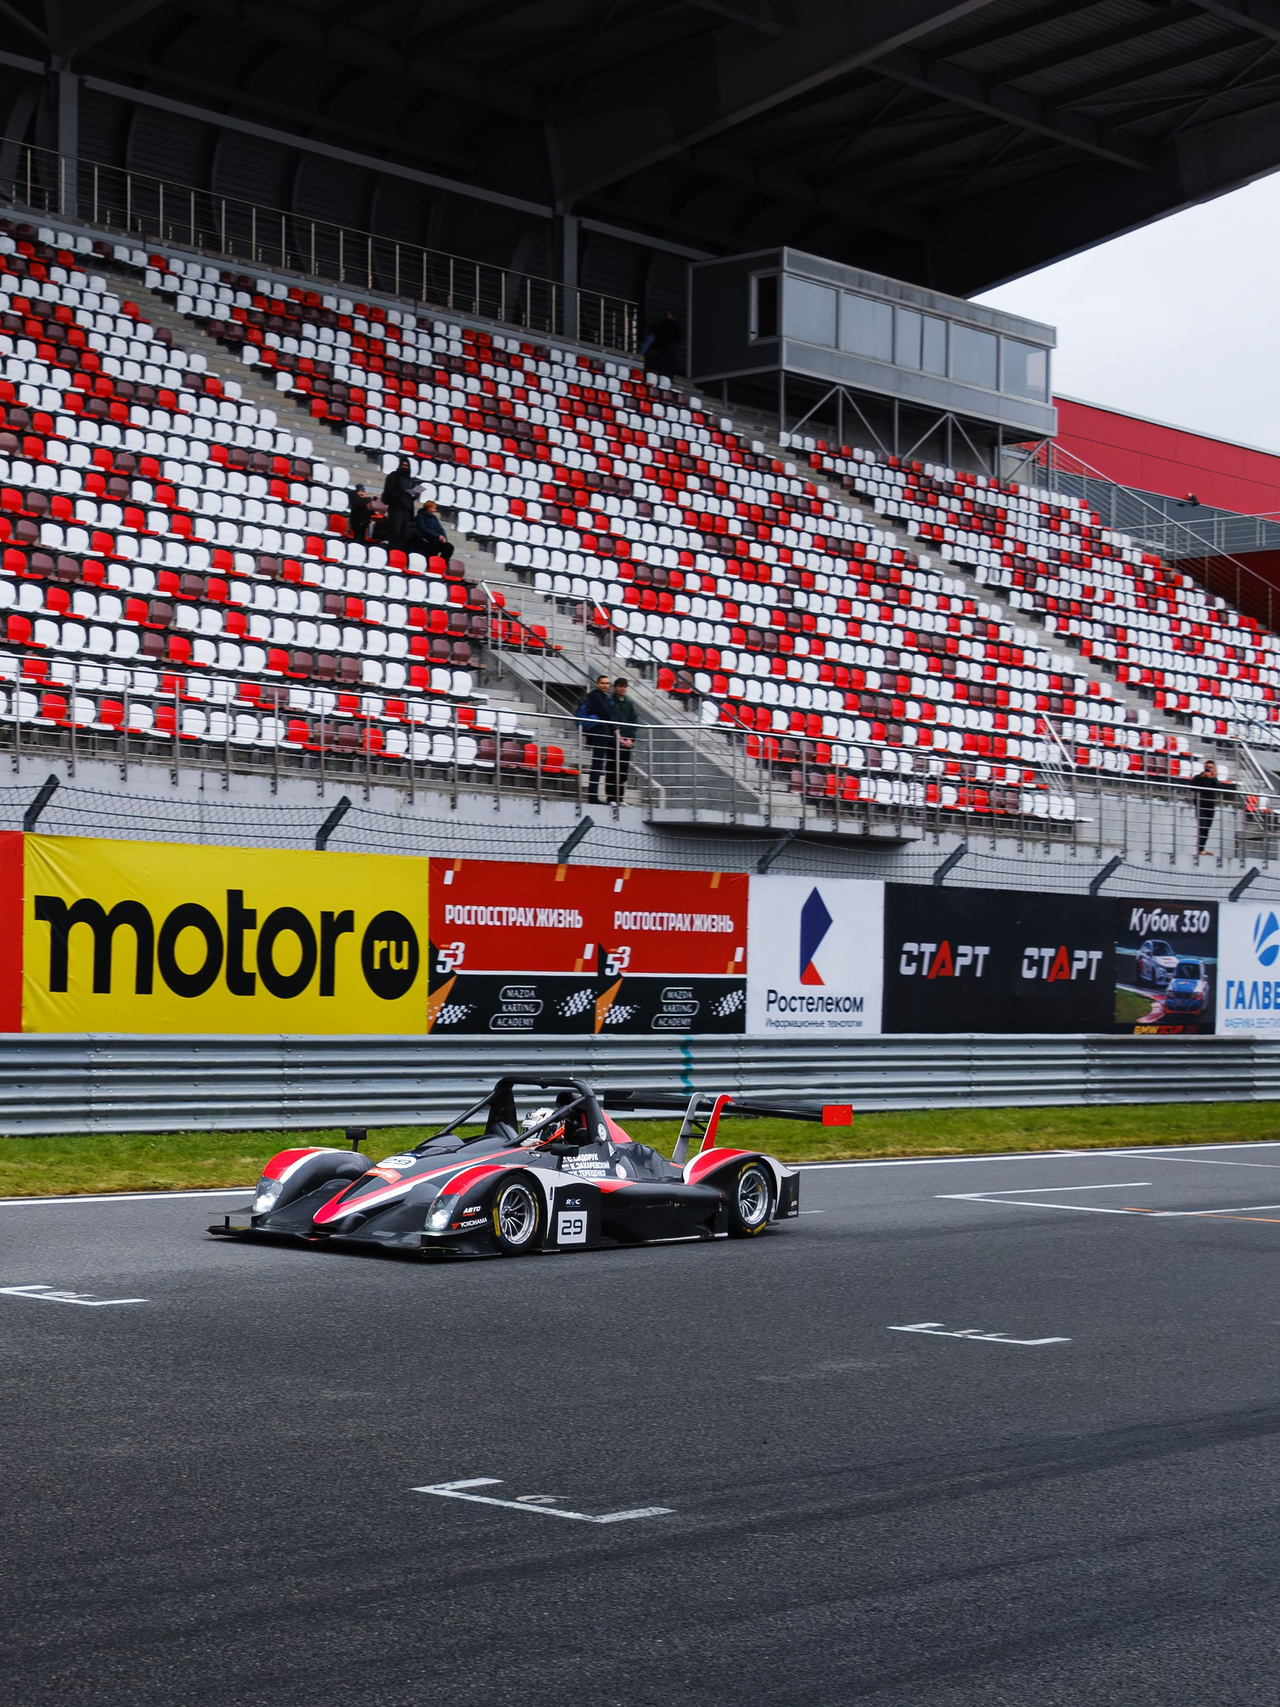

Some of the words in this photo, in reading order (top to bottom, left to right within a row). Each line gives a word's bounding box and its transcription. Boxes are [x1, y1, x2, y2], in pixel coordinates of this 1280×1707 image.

[445, 904, 534, 927] РОСГОССТРАХ
[535, 908, 584, 929] ЖИЗНЬ
[614, 911, 692, 931] РОСГОССТРАХ
[692, 914, 735, 933] ЖИЗНЬ
[1129, 908, 1179, 936] Кубок
[1181, 910, 1210, 933] 330
[34, 889, 355, 999] motor
[899, 940, 991, 979] СТАРТ
[1021, 945, 1103, 982] СТАРТ
[506, 989, 536, 998] MAZDA
[766, 989, 864, 1013] Ростелеком
[496, 1017, 535, 1026] ACADEMY
[460, 1217, 488, 1228] YOKOHAMA
[561, 1219, 583, 1236] 29
